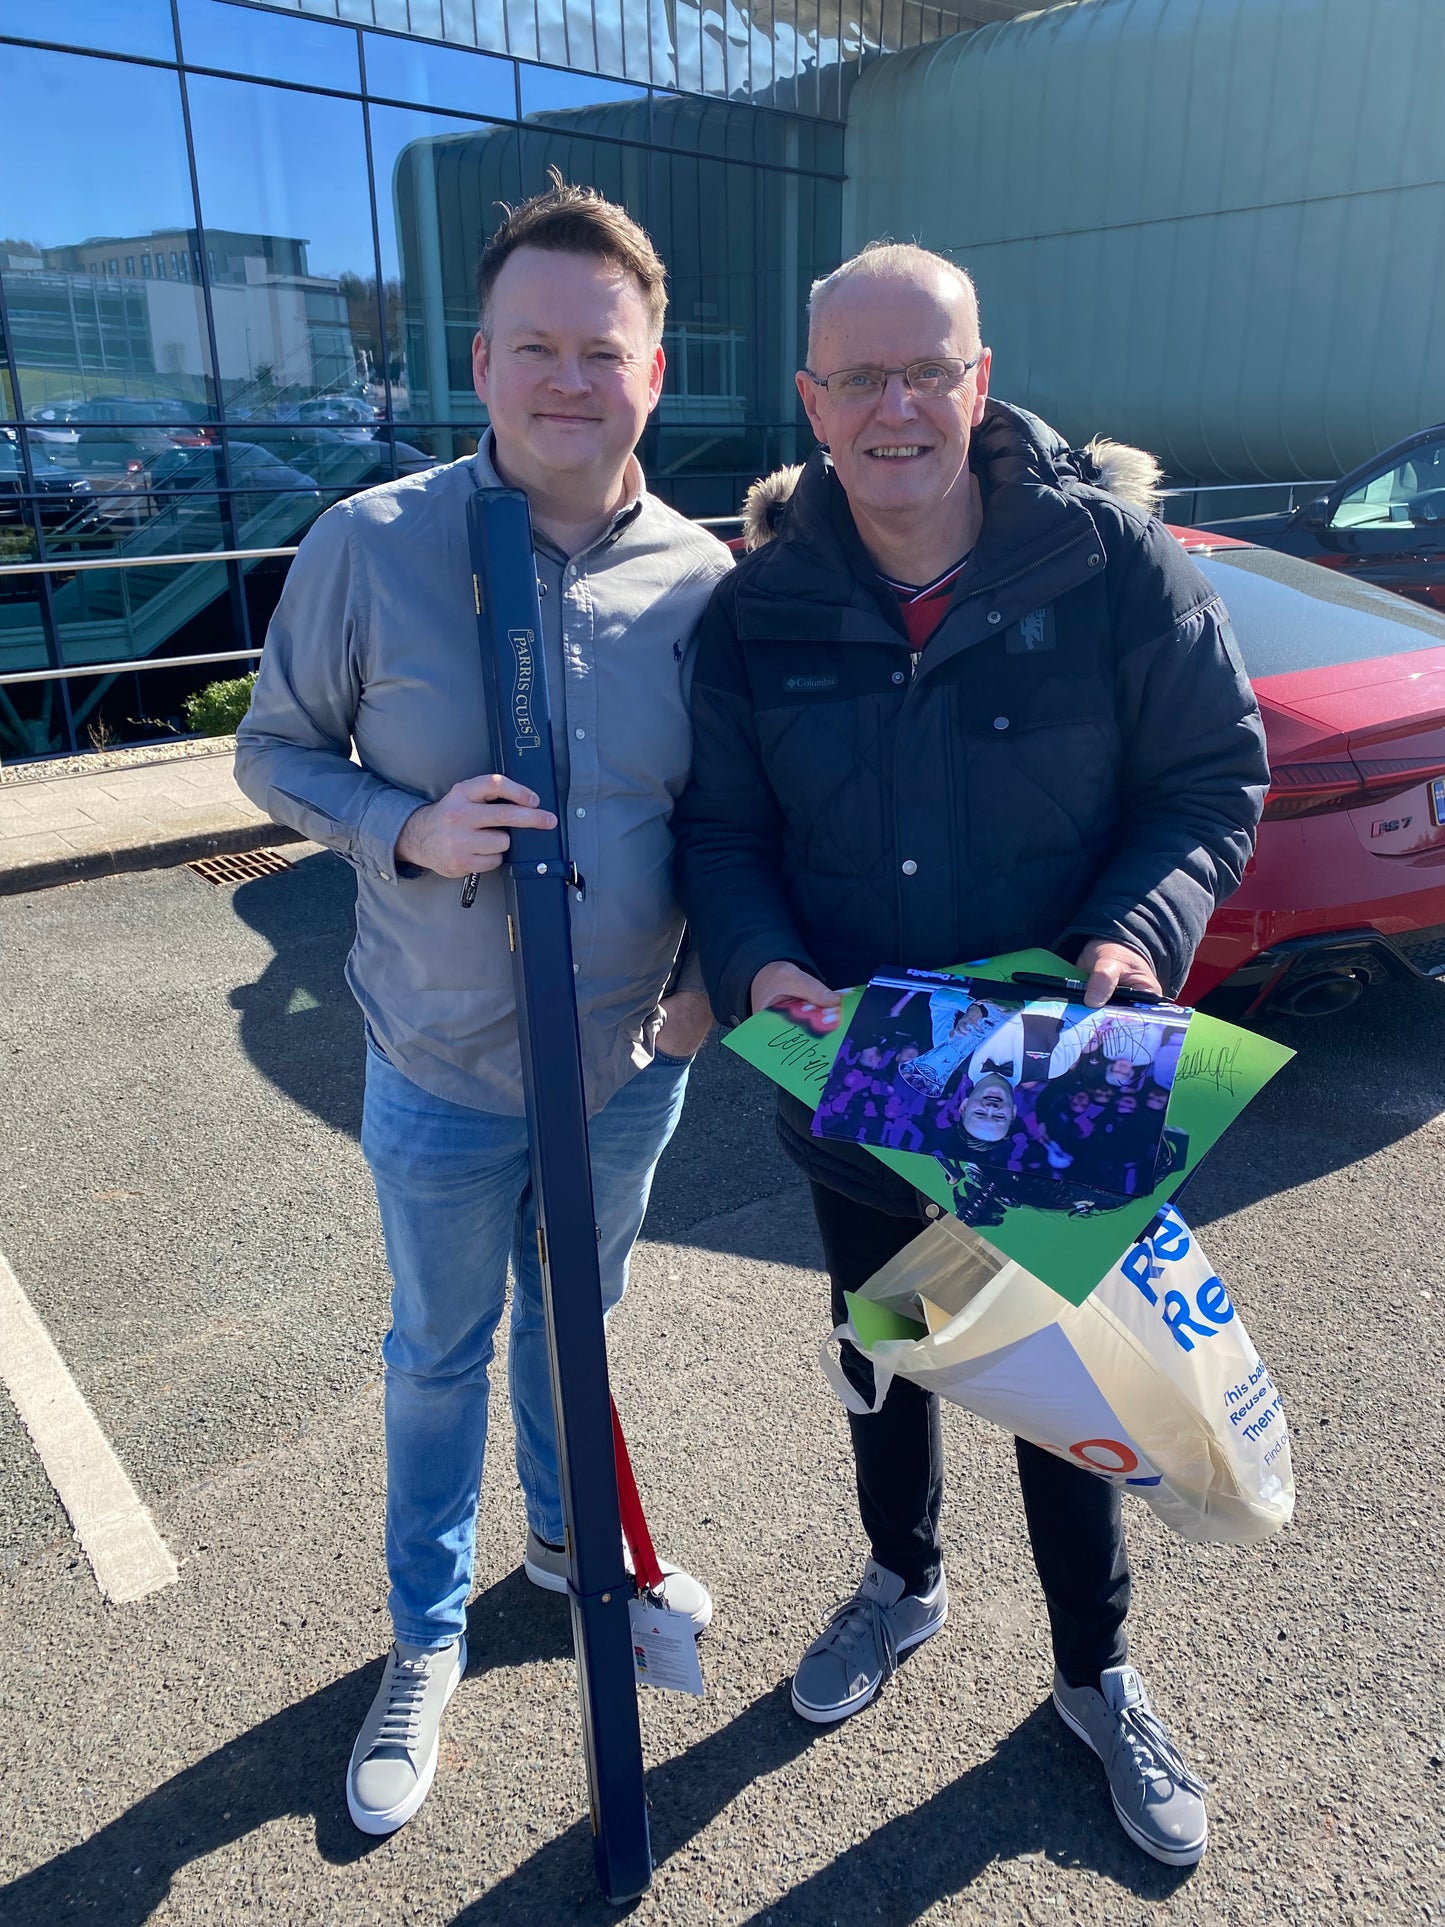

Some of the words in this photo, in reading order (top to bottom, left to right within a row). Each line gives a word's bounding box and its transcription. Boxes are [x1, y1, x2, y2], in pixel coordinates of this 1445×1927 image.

[513, 637, 532, 691] PARRIS
[515, 694, 533, 734] CUES
[1162, 1276, 1235, 1352] Re
[1229, 1387, 1267, 1426] Reuse
[1242, 1408, 1276, 1442] Then
[1264, 1441, 1282, 1466] Find
